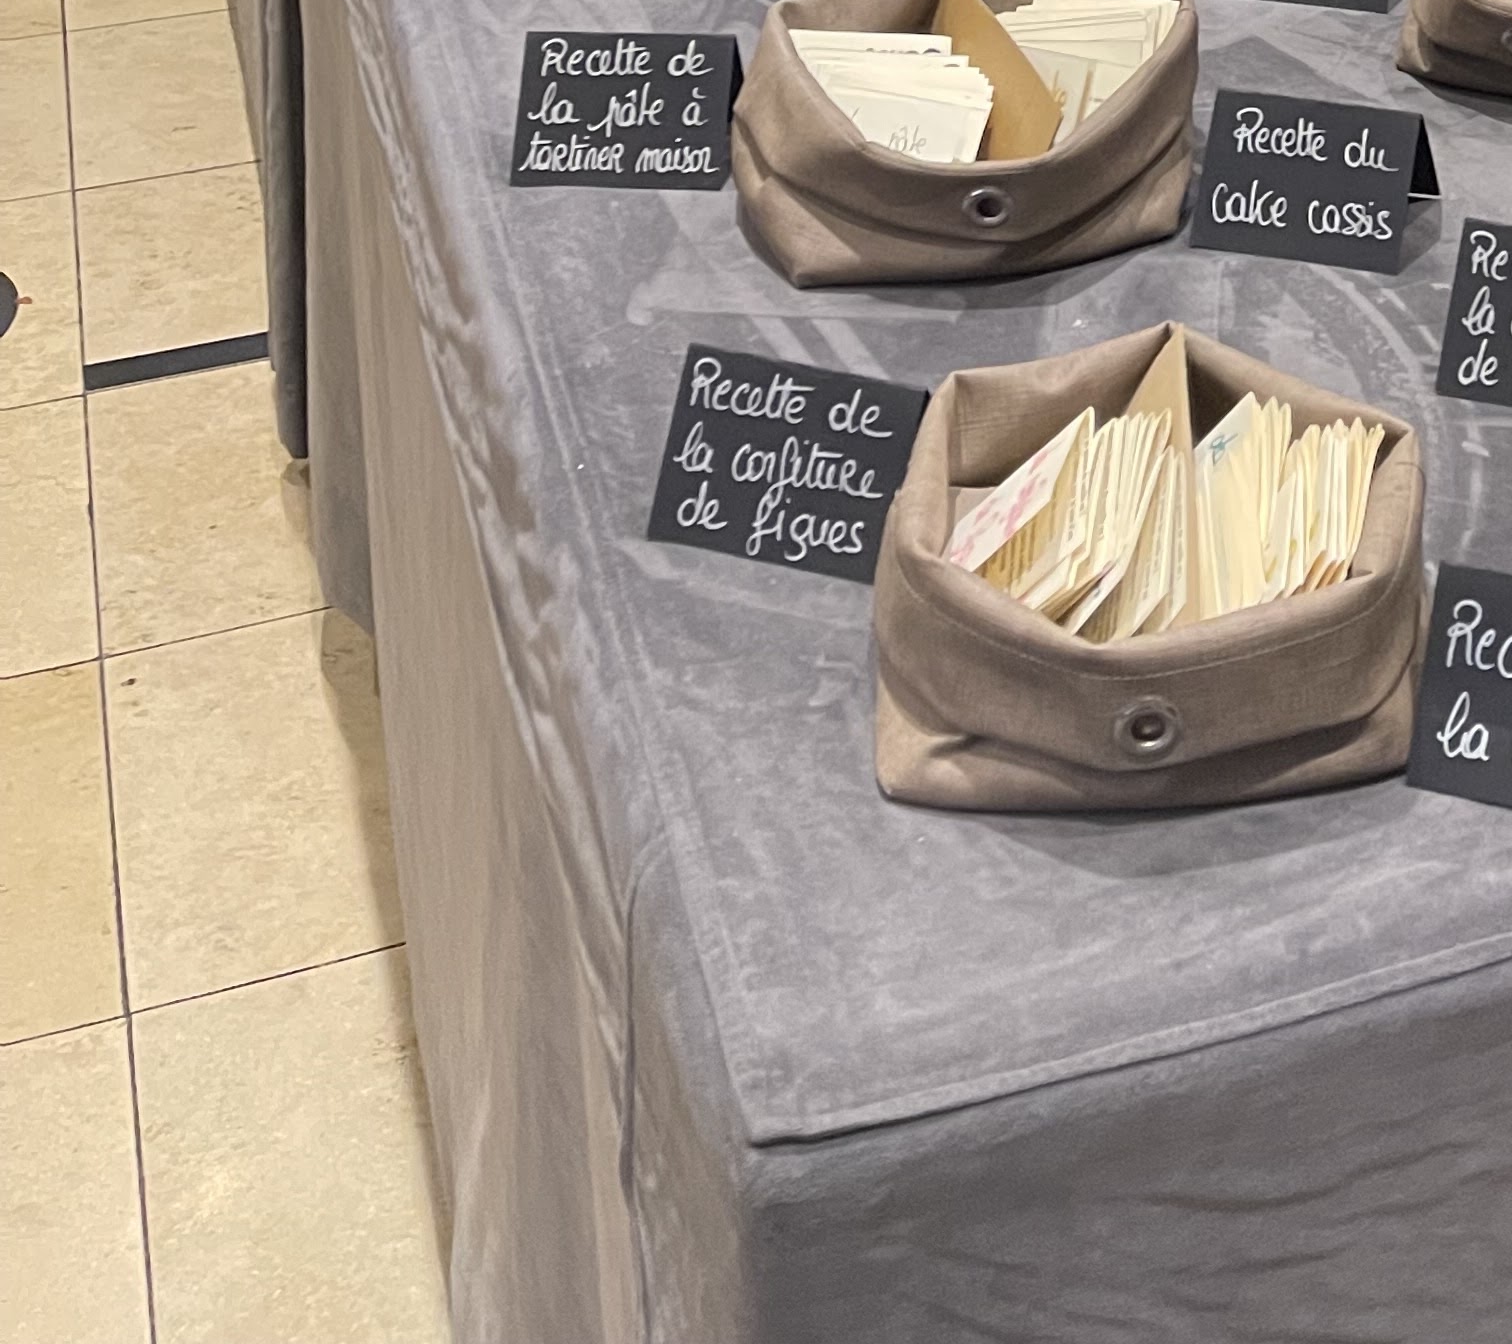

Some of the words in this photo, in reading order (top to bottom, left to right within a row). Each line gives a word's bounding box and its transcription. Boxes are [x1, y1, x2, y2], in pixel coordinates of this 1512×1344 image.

[540, 37, 653, 77] Recette
[667, 39, 714, 77] de
[527, 81, 580, 125] la
[587, 81, 665, 138] pâte
[682, 87, 709, 126] à
[634, 137, 720, 174] maison
[1233, 106, 1328, 162] Recette
[1343, 127, 1400, 172] du
[1307, 199, 1394, 241] cassis
[1461, 284, 1496, 336] la
[1457, 338, 1500, 387] de
[689, 357, 817, 425] Recette
[828, 388, 893, 439] de
[673, 421, 716, 474] la
[731, 435, 884, 500] confiture
[676, 480, 728, 531] de
[745, 492, 866, 562] figues
[1435, 690, 1490, 762] la
